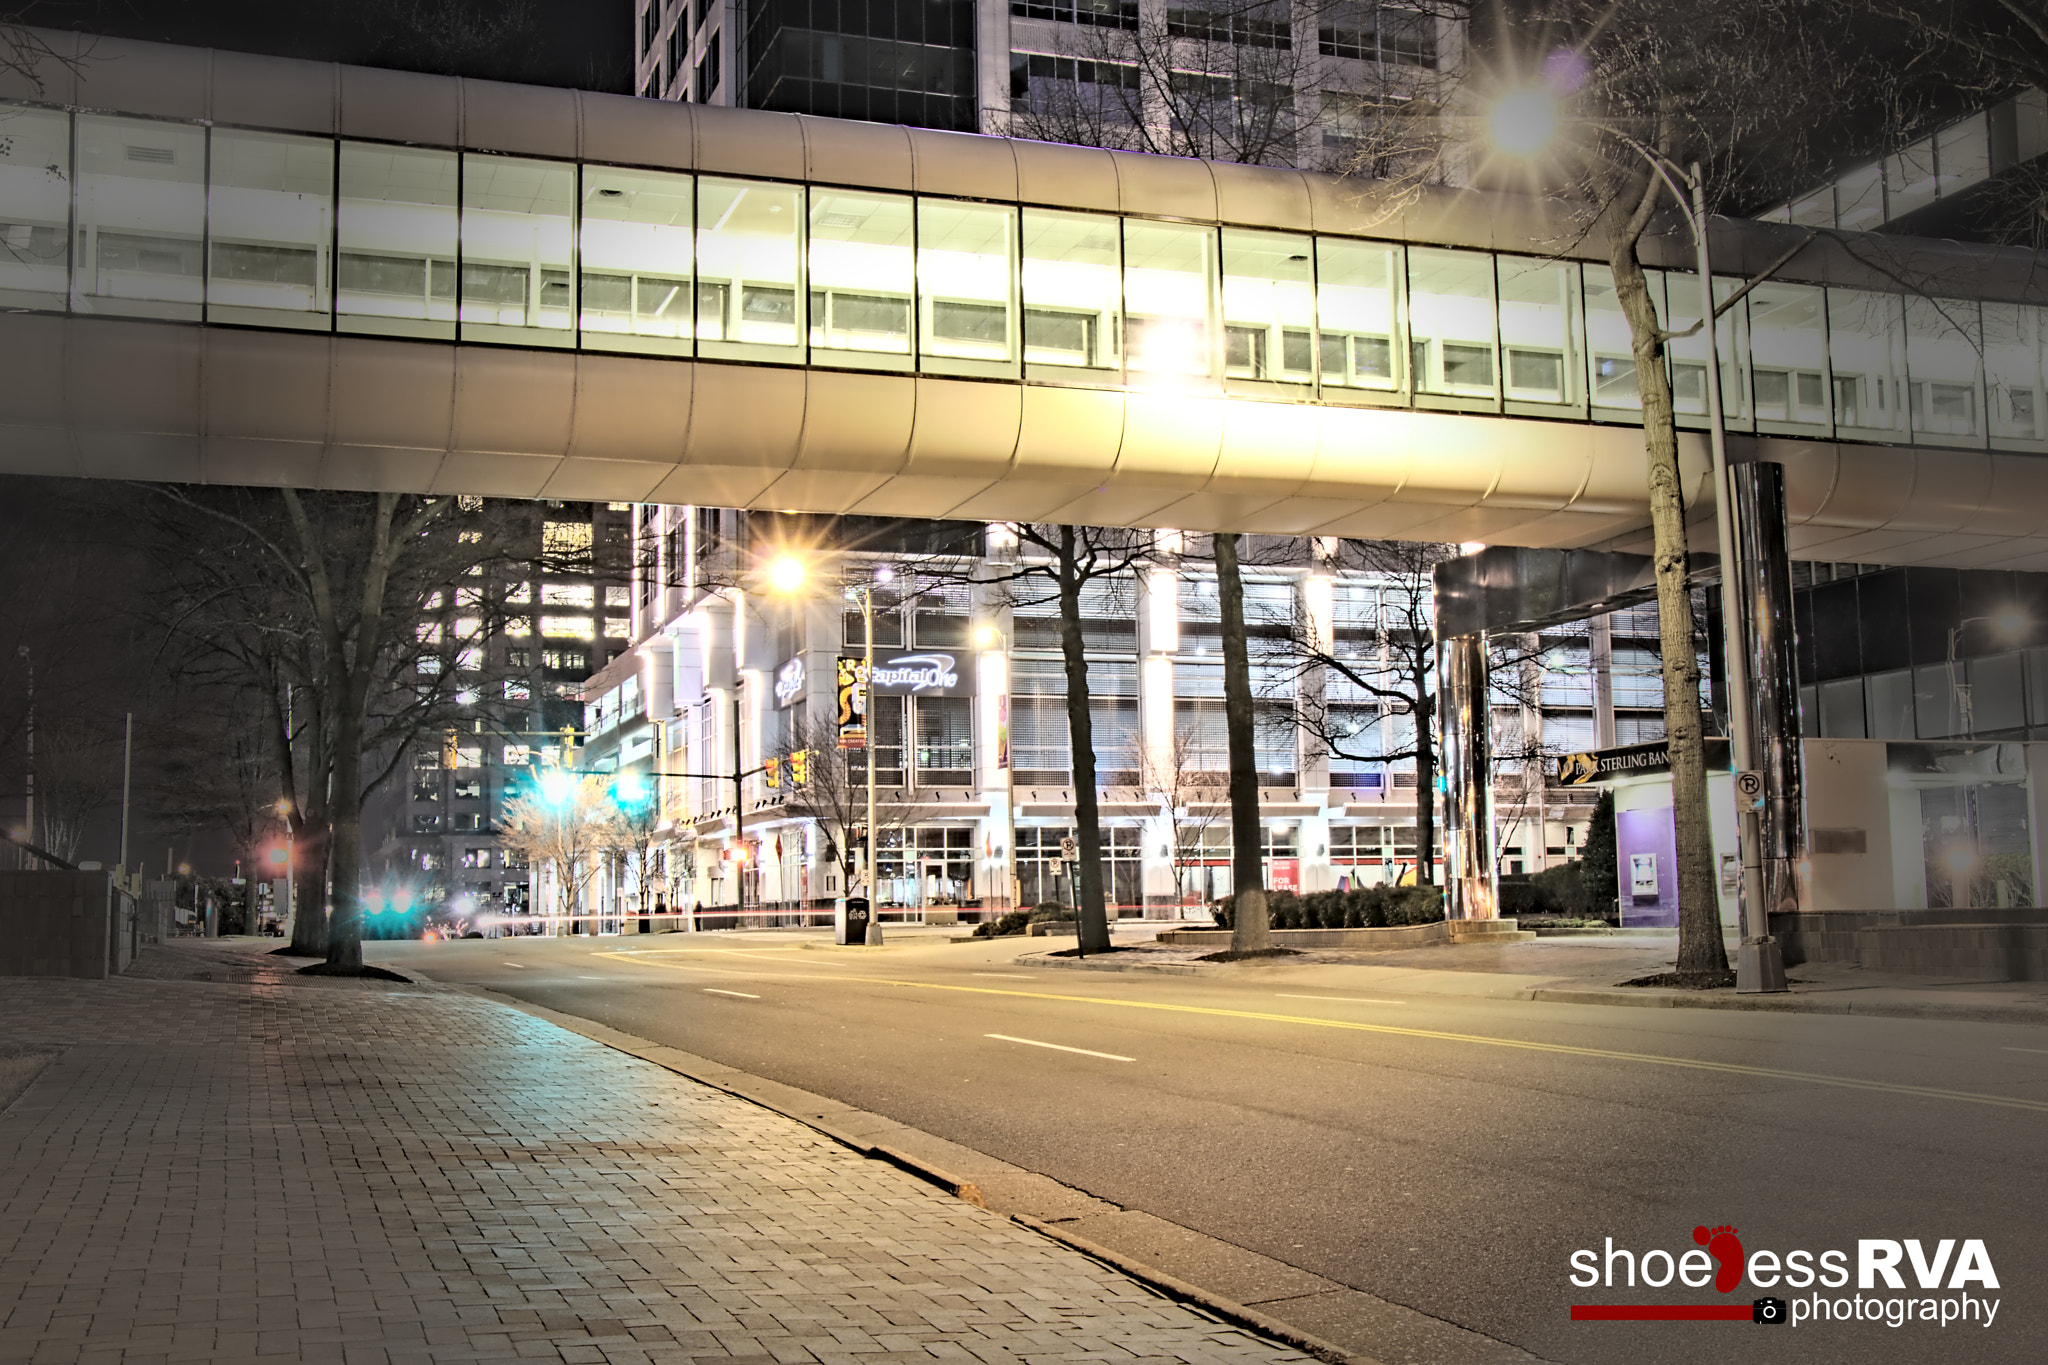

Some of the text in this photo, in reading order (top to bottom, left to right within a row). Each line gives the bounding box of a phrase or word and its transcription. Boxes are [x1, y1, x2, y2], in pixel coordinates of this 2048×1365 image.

[1600, 753, 1647, 772] STERLING
[1648, 750, 1670, 766] BAN
[1273, 877, 1290, 885] FOR
